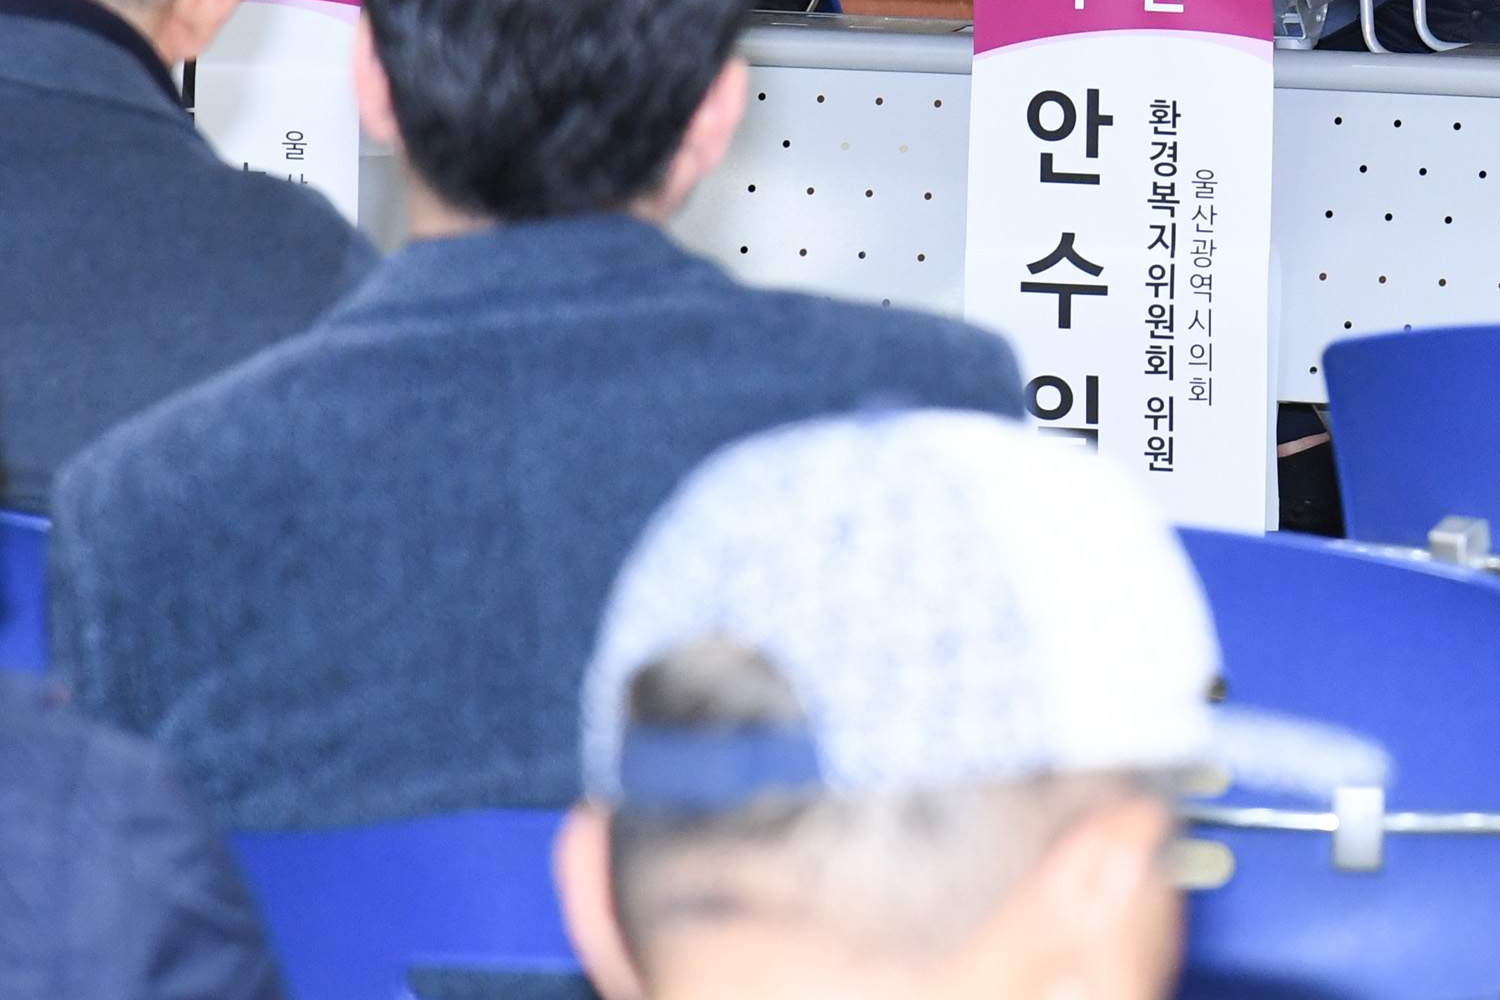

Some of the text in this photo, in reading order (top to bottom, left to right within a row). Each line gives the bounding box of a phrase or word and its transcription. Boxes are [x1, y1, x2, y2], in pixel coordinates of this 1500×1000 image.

[1144, 99, 1182, 472] 환경복지위원회 위원
[1187, 168, 1219, 407] 울산광역시의회
